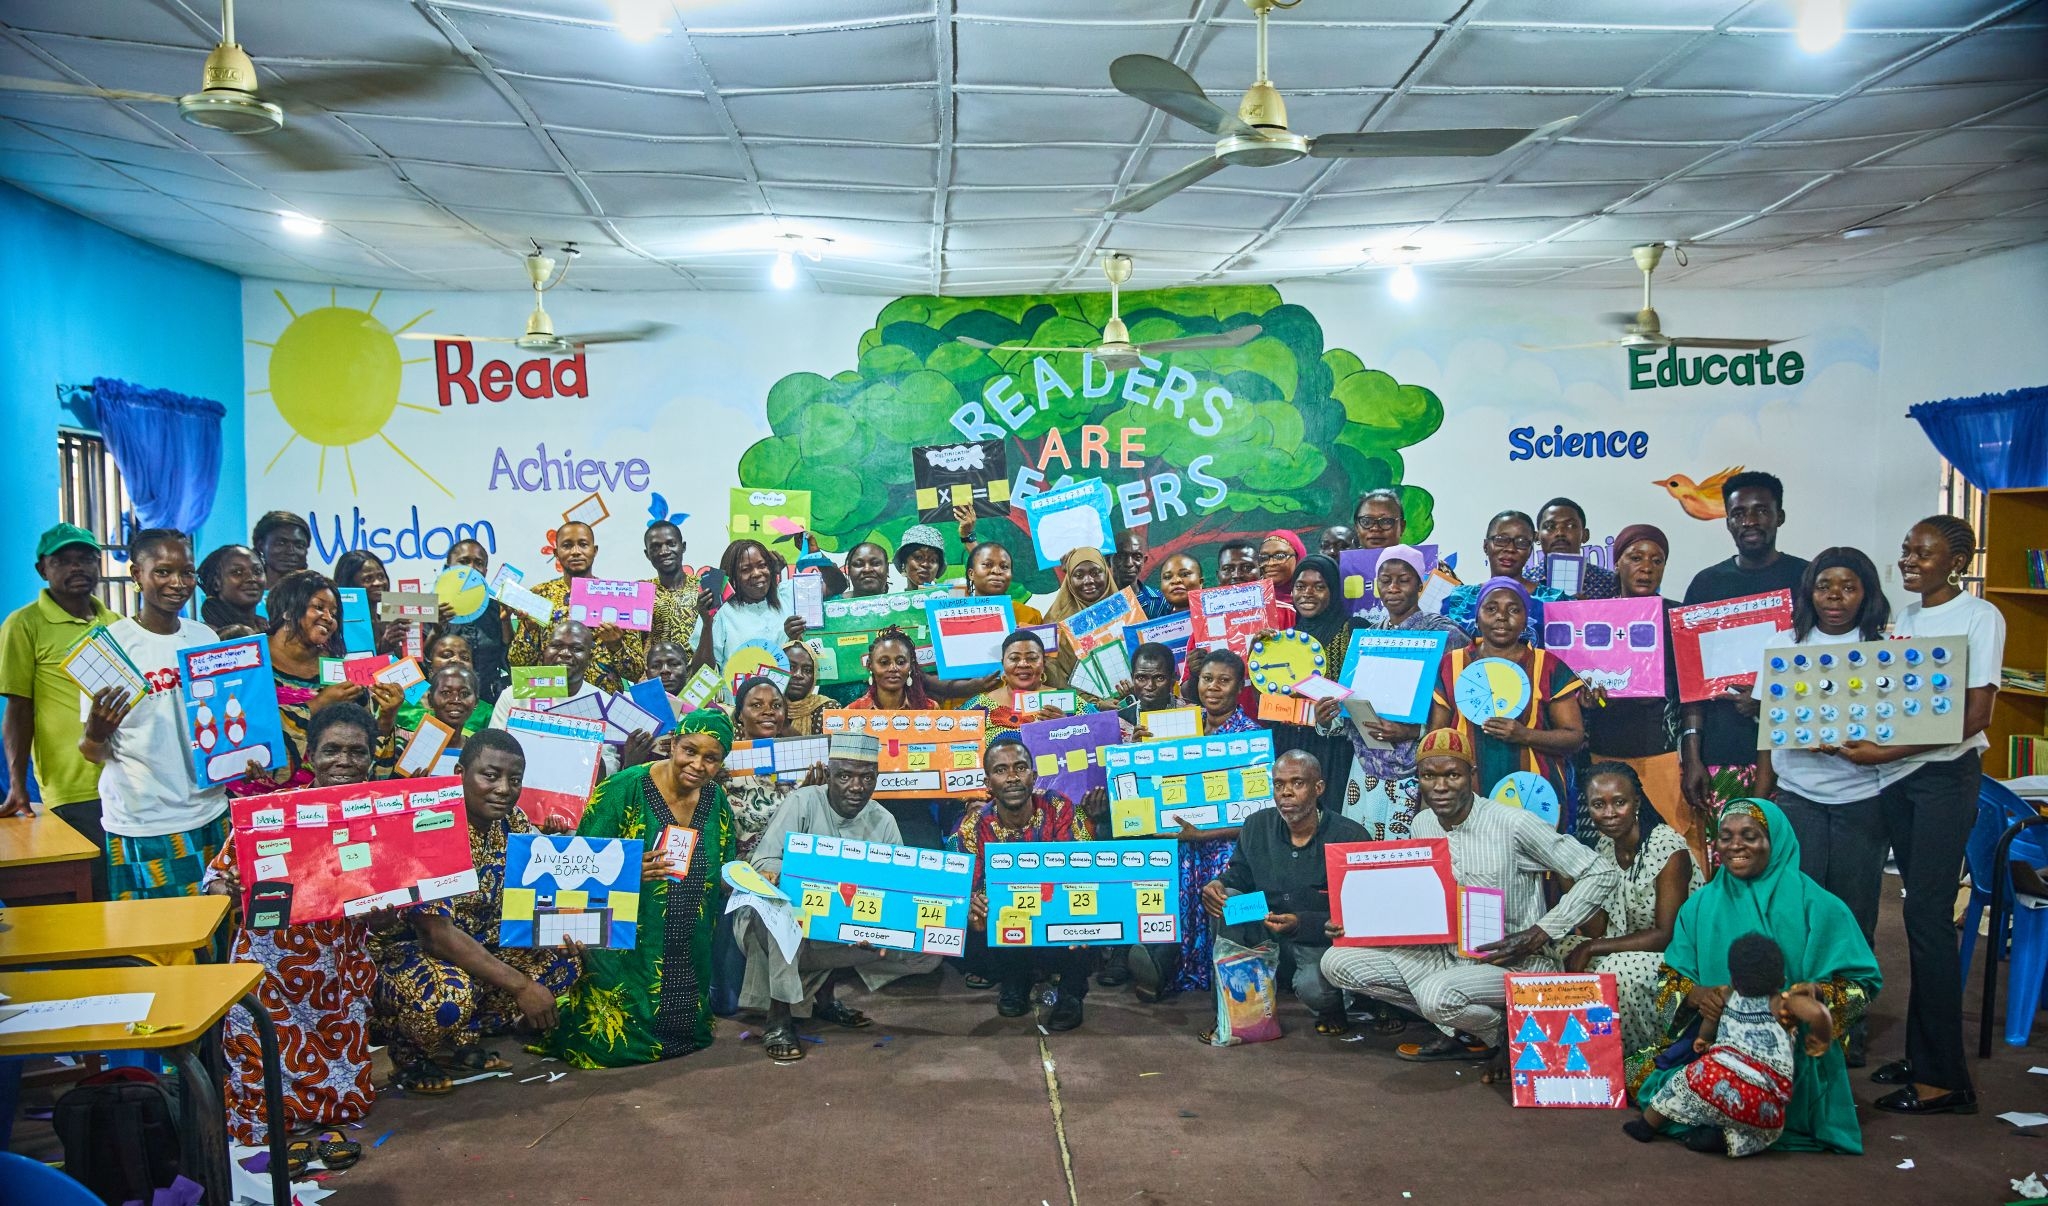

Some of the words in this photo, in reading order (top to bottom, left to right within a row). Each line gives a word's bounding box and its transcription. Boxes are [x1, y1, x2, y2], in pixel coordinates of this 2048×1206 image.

[433, 336, 589, 407] Read
[1629, 346, 1805, 390] Educate
[950, 353, 1233, 442] READERS
[1038, 424, 1147, 470] ARE
[1509, 424, 1649, 461] Science
[488, 443, 651, 493] Achieve
[1009, 455, 1228, 530] EERS
[309, 506, 497, 565] Wisdom
[940, 598, 969, 608] NUMBER
[1712, 608, 1720, 616] 4
[1723, 606, 1730, 614] 5
[1733, 605, 1740, 613] 6
[1771, 598, 1781, 606] 10
[1376, 638, 1381, 646] 3
[1399, 638, 1404, 646] 6
[910, 754, 926, 766] 22
[957, 754, 973, 765] 23
[881, 777, 918, 787] October
[948, 775, 985, 787] 2025
[1167, 788, 1183, 801] 21
[1207, 785, 1227, 798] 22
[1248, 780, 1266, 794] 23
[671, 834, 690, 849] 34
[791, 838, 808, 849] Sunday
[816, 841, 834, 850] Monday
[843, 844, 862, 854] Tuesday
[534, 852, 596, 865] DIVISION
[679, 851, 687, 861] 4
[992, 855, 1011, 866] Sunday
[1018, 856, 1037, 865] Monday
[1045, 856, 1065, 865] Tuesday
[261, 865, 272, 873] 22
[553, 864, 600, 877] BOARD
[434, 875, 461, 888] 2025
[804, 894, 825, 907] 22
[857, 900, 877, 915] 23
[921, 906, 942, 921] 24
[1017, 896, 1036, 909] 22
[1073, 893, 1090, 907] 23
[1142, 893, 1162, 906] 24
[1063, 927, 1101, 936] October
[1143, 921, 1173, 933] 2025
[853, 930, 890, 941] October
[927, 932, 960, 946] 2025
